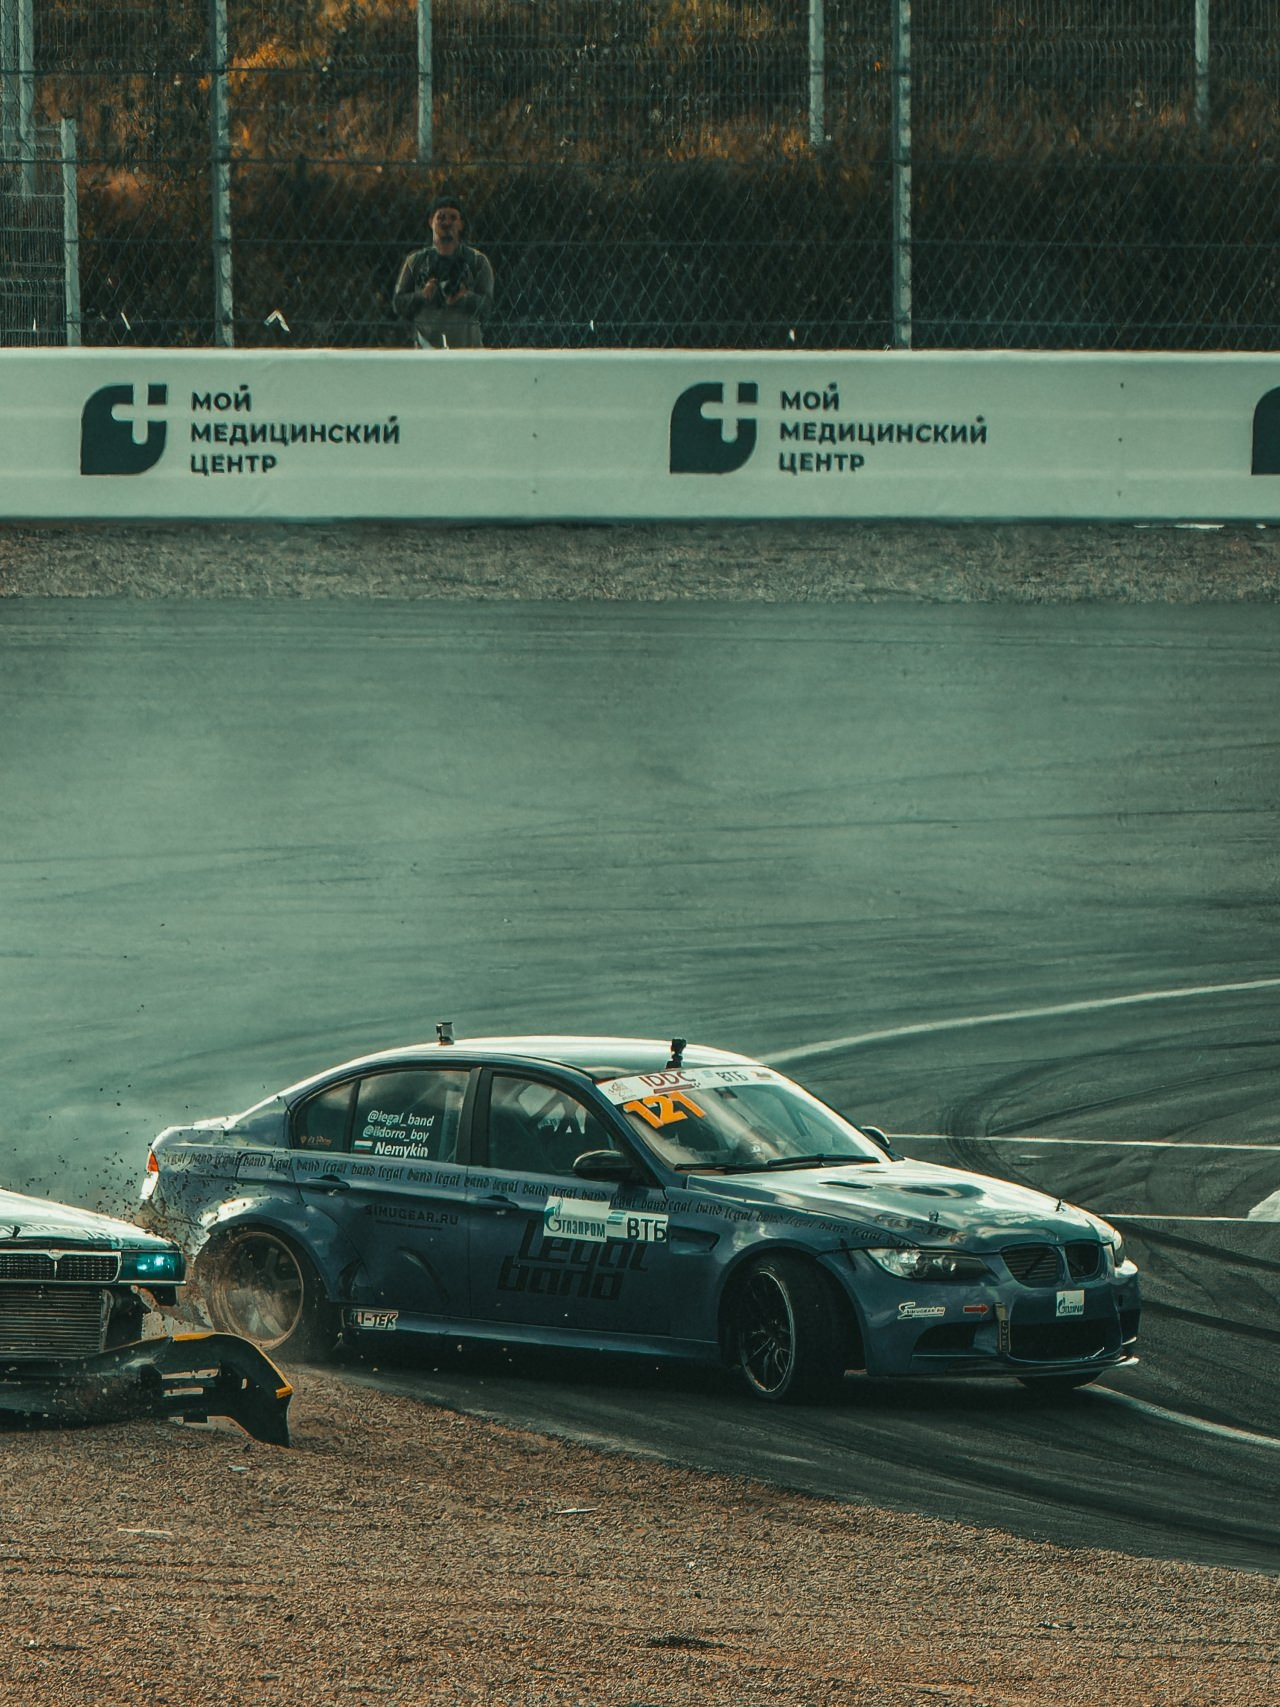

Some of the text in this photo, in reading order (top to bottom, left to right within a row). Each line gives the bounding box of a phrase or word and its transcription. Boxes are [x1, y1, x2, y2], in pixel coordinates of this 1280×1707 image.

[191, 384, 252, 411] МОЙ
[780, 382, 840, 411] МОЙ
[191, 415, 400, 446] МЕДИЦИНСКИЙ
[779, 415, 987, 446] МЕДИЦИНСКИЙ
[190, 454, 277, 476] ЦЕНТР
[778, 452, 865, 475] ЦЕНТР
[638, 1071, 697, 1088] IDDC
[367, 1109, 435, 1127] @legal_band
[623, 1091, 706, 1129] 121
[374, 1141, 429, 1159] Nemykin
[364, 1203, 459, 1225] SIMUGEAR.RU
[561, 1219, 606, 1238] ГАЗПРОМ
[626, 1217, 668, 1241] ВТБ
